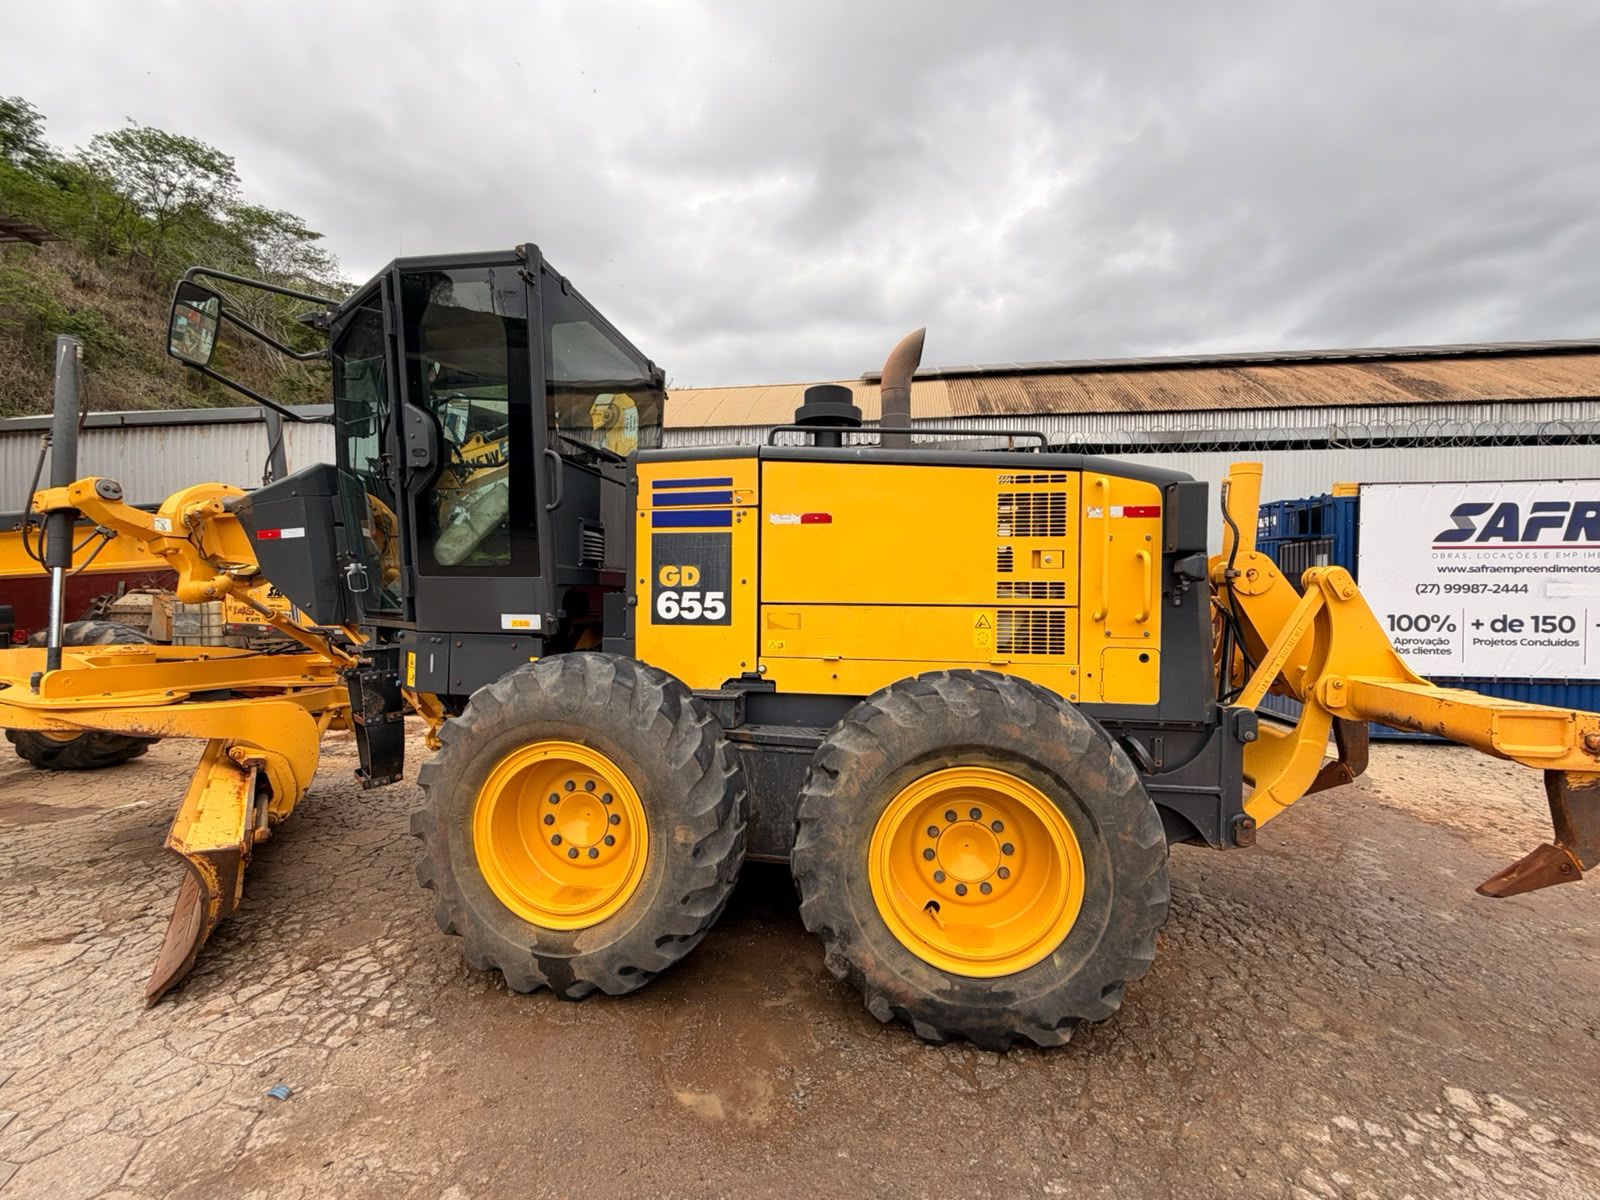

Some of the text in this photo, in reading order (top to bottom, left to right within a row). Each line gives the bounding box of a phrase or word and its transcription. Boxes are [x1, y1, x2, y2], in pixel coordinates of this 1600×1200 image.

[1432, 501, 1600, 543] SAFR
[1431, 552, 1472, 560] OBRAS,
[1477, 551, 1538, 561] LOCAÇÕES
[1543, 551, 1550, 559] E
[1555, 551, 1579, 559] EMP
[658, 565, 701, 587] GD
[1415, 583, 1529, 595] (27) 99987-2444
[656, 590, 726, 620] 655
[1387, 614, 1457, 633] 100%
[1471, 614, 1576, 634] + de 150
[1393, 636, 1451, 647] Aprovação
[1472, 637, 1580, 648] Projetos Concluídos
[1412, 646, 1453, 656] clientes
